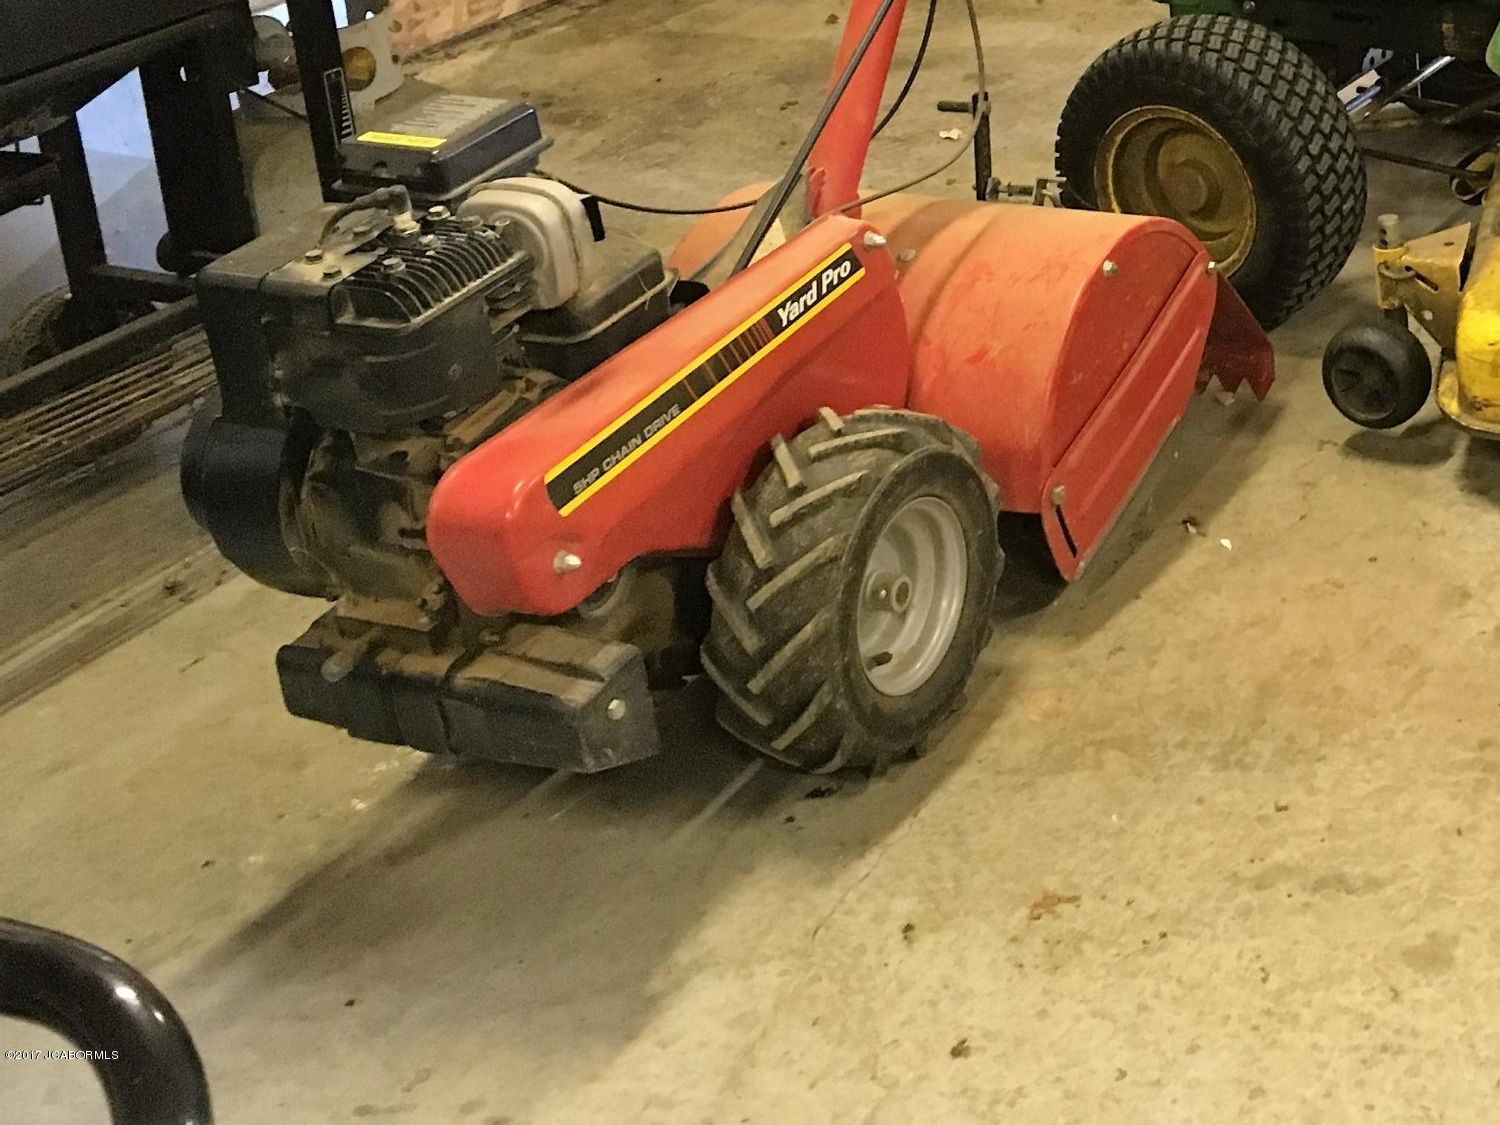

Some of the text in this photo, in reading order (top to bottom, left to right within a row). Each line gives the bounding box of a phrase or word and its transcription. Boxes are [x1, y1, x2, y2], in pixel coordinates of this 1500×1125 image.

[777, 260, 851, 328] Yard Pro
[602, 434, 643, 472] CHAIN
[643, 403, 682, 439] DRIVE
